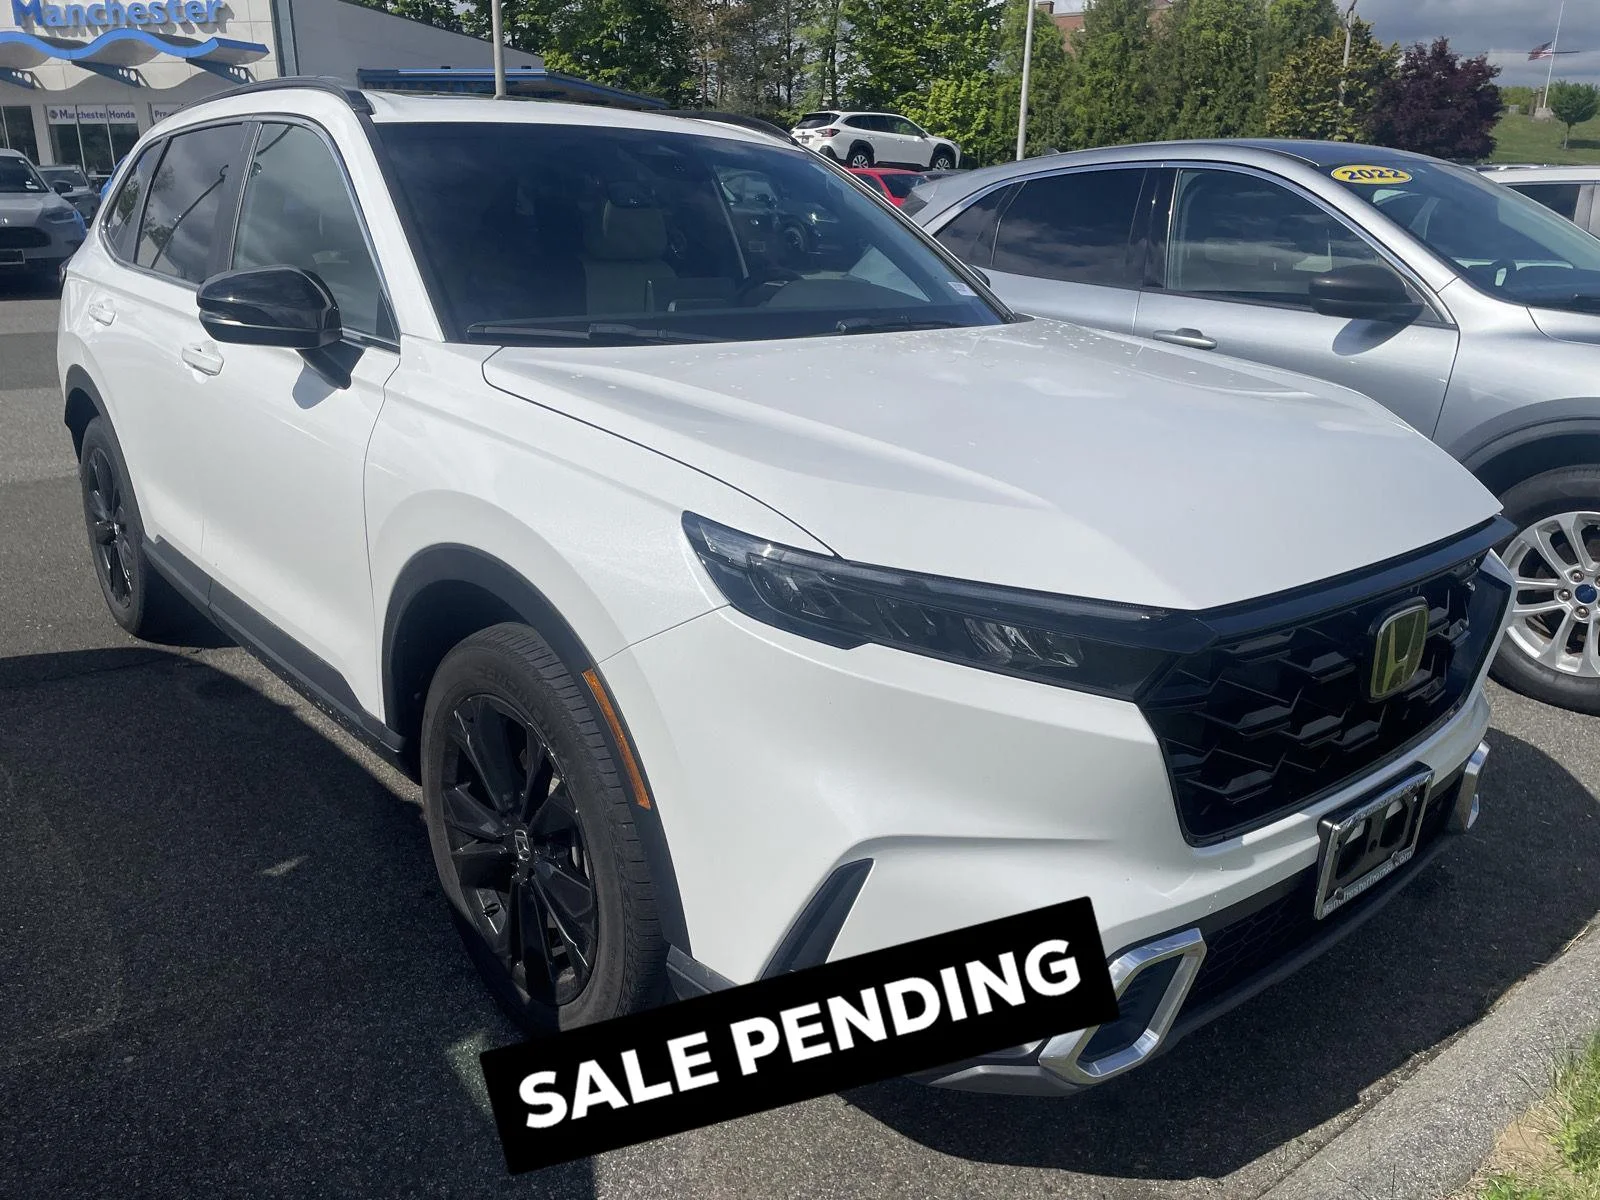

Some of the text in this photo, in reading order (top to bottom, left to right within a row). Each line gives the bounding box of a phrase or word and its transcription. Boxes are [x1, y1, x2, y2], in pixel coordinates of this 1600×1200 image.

[12, 0, 223, 26] Manchester
[108, 108, 135, 118] Honda
[1341, 168, 1407, 180] 2022
